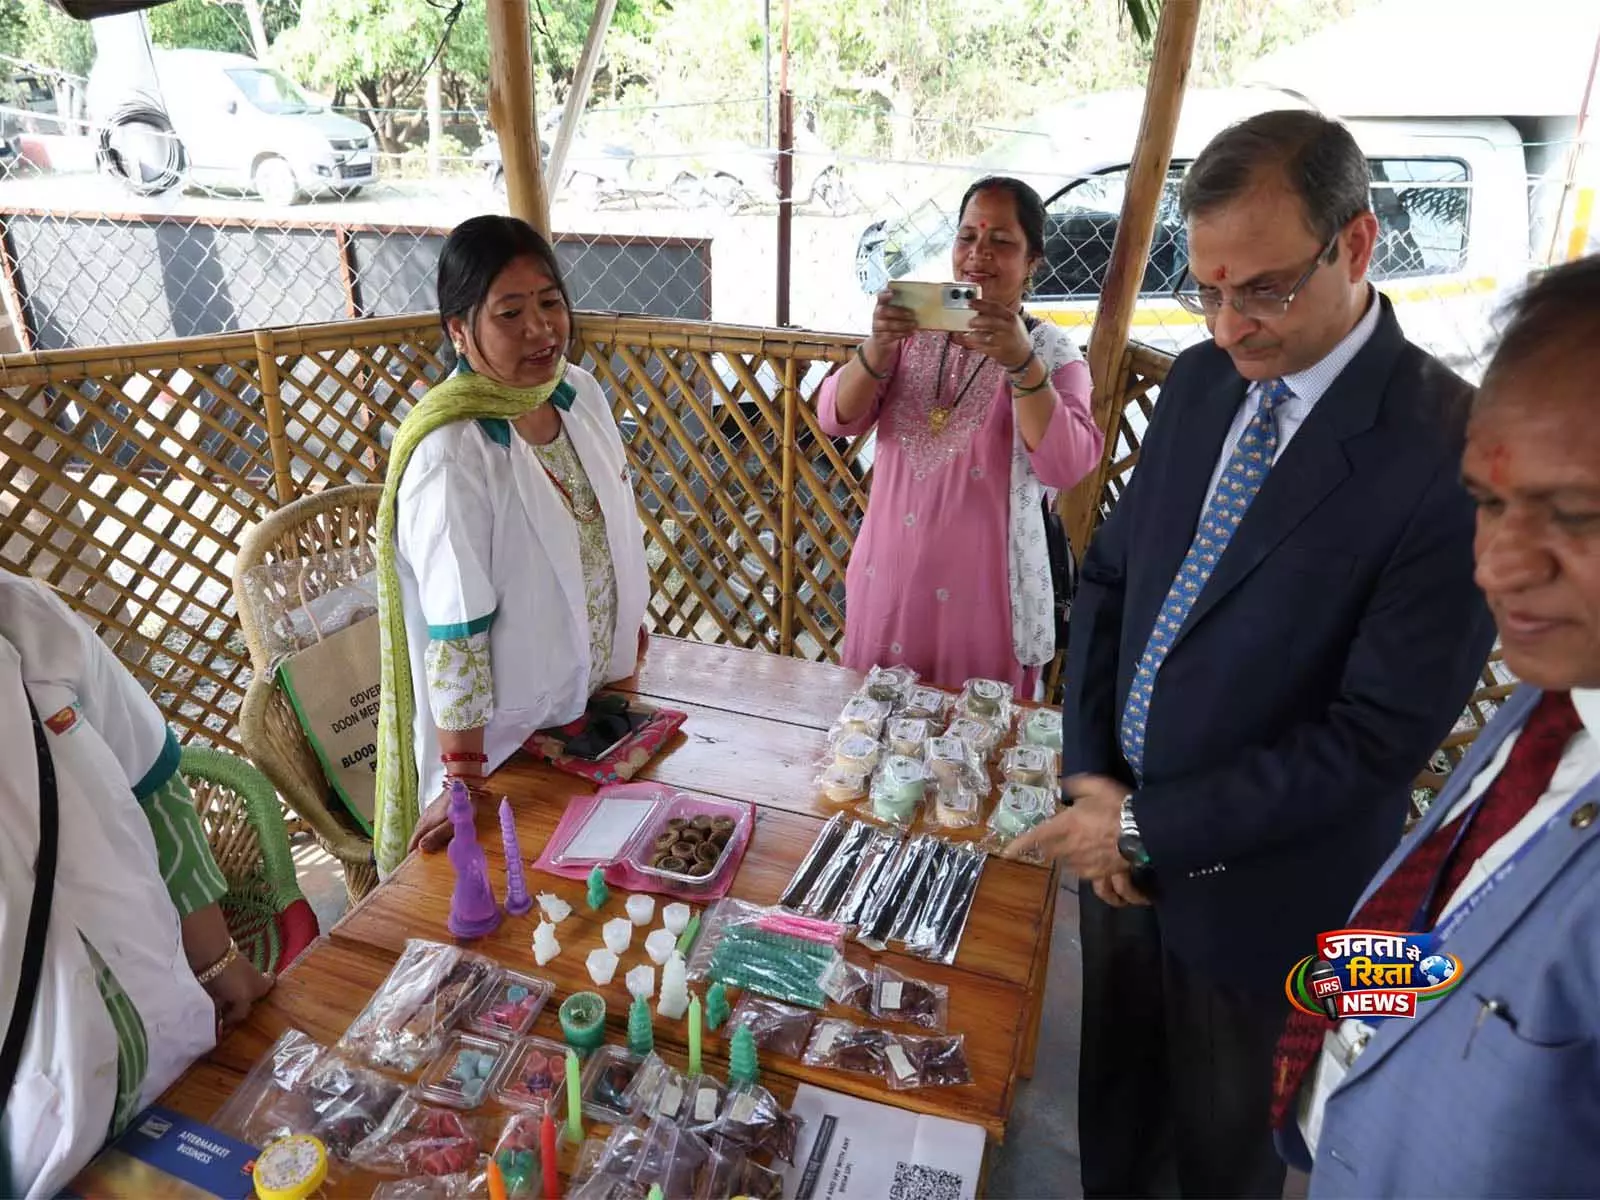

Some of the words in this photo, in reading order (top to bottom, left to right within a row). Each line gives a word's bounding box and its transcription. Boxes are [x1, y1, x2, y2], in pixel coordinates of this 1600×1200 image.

[331, 712, 360, 734] DOON
[341, 743, 377, 769] BLOOD
[176, 1143, 212, 1164] BUSINESS
[177, 1130, 231, 1158] AFTERMARKET
